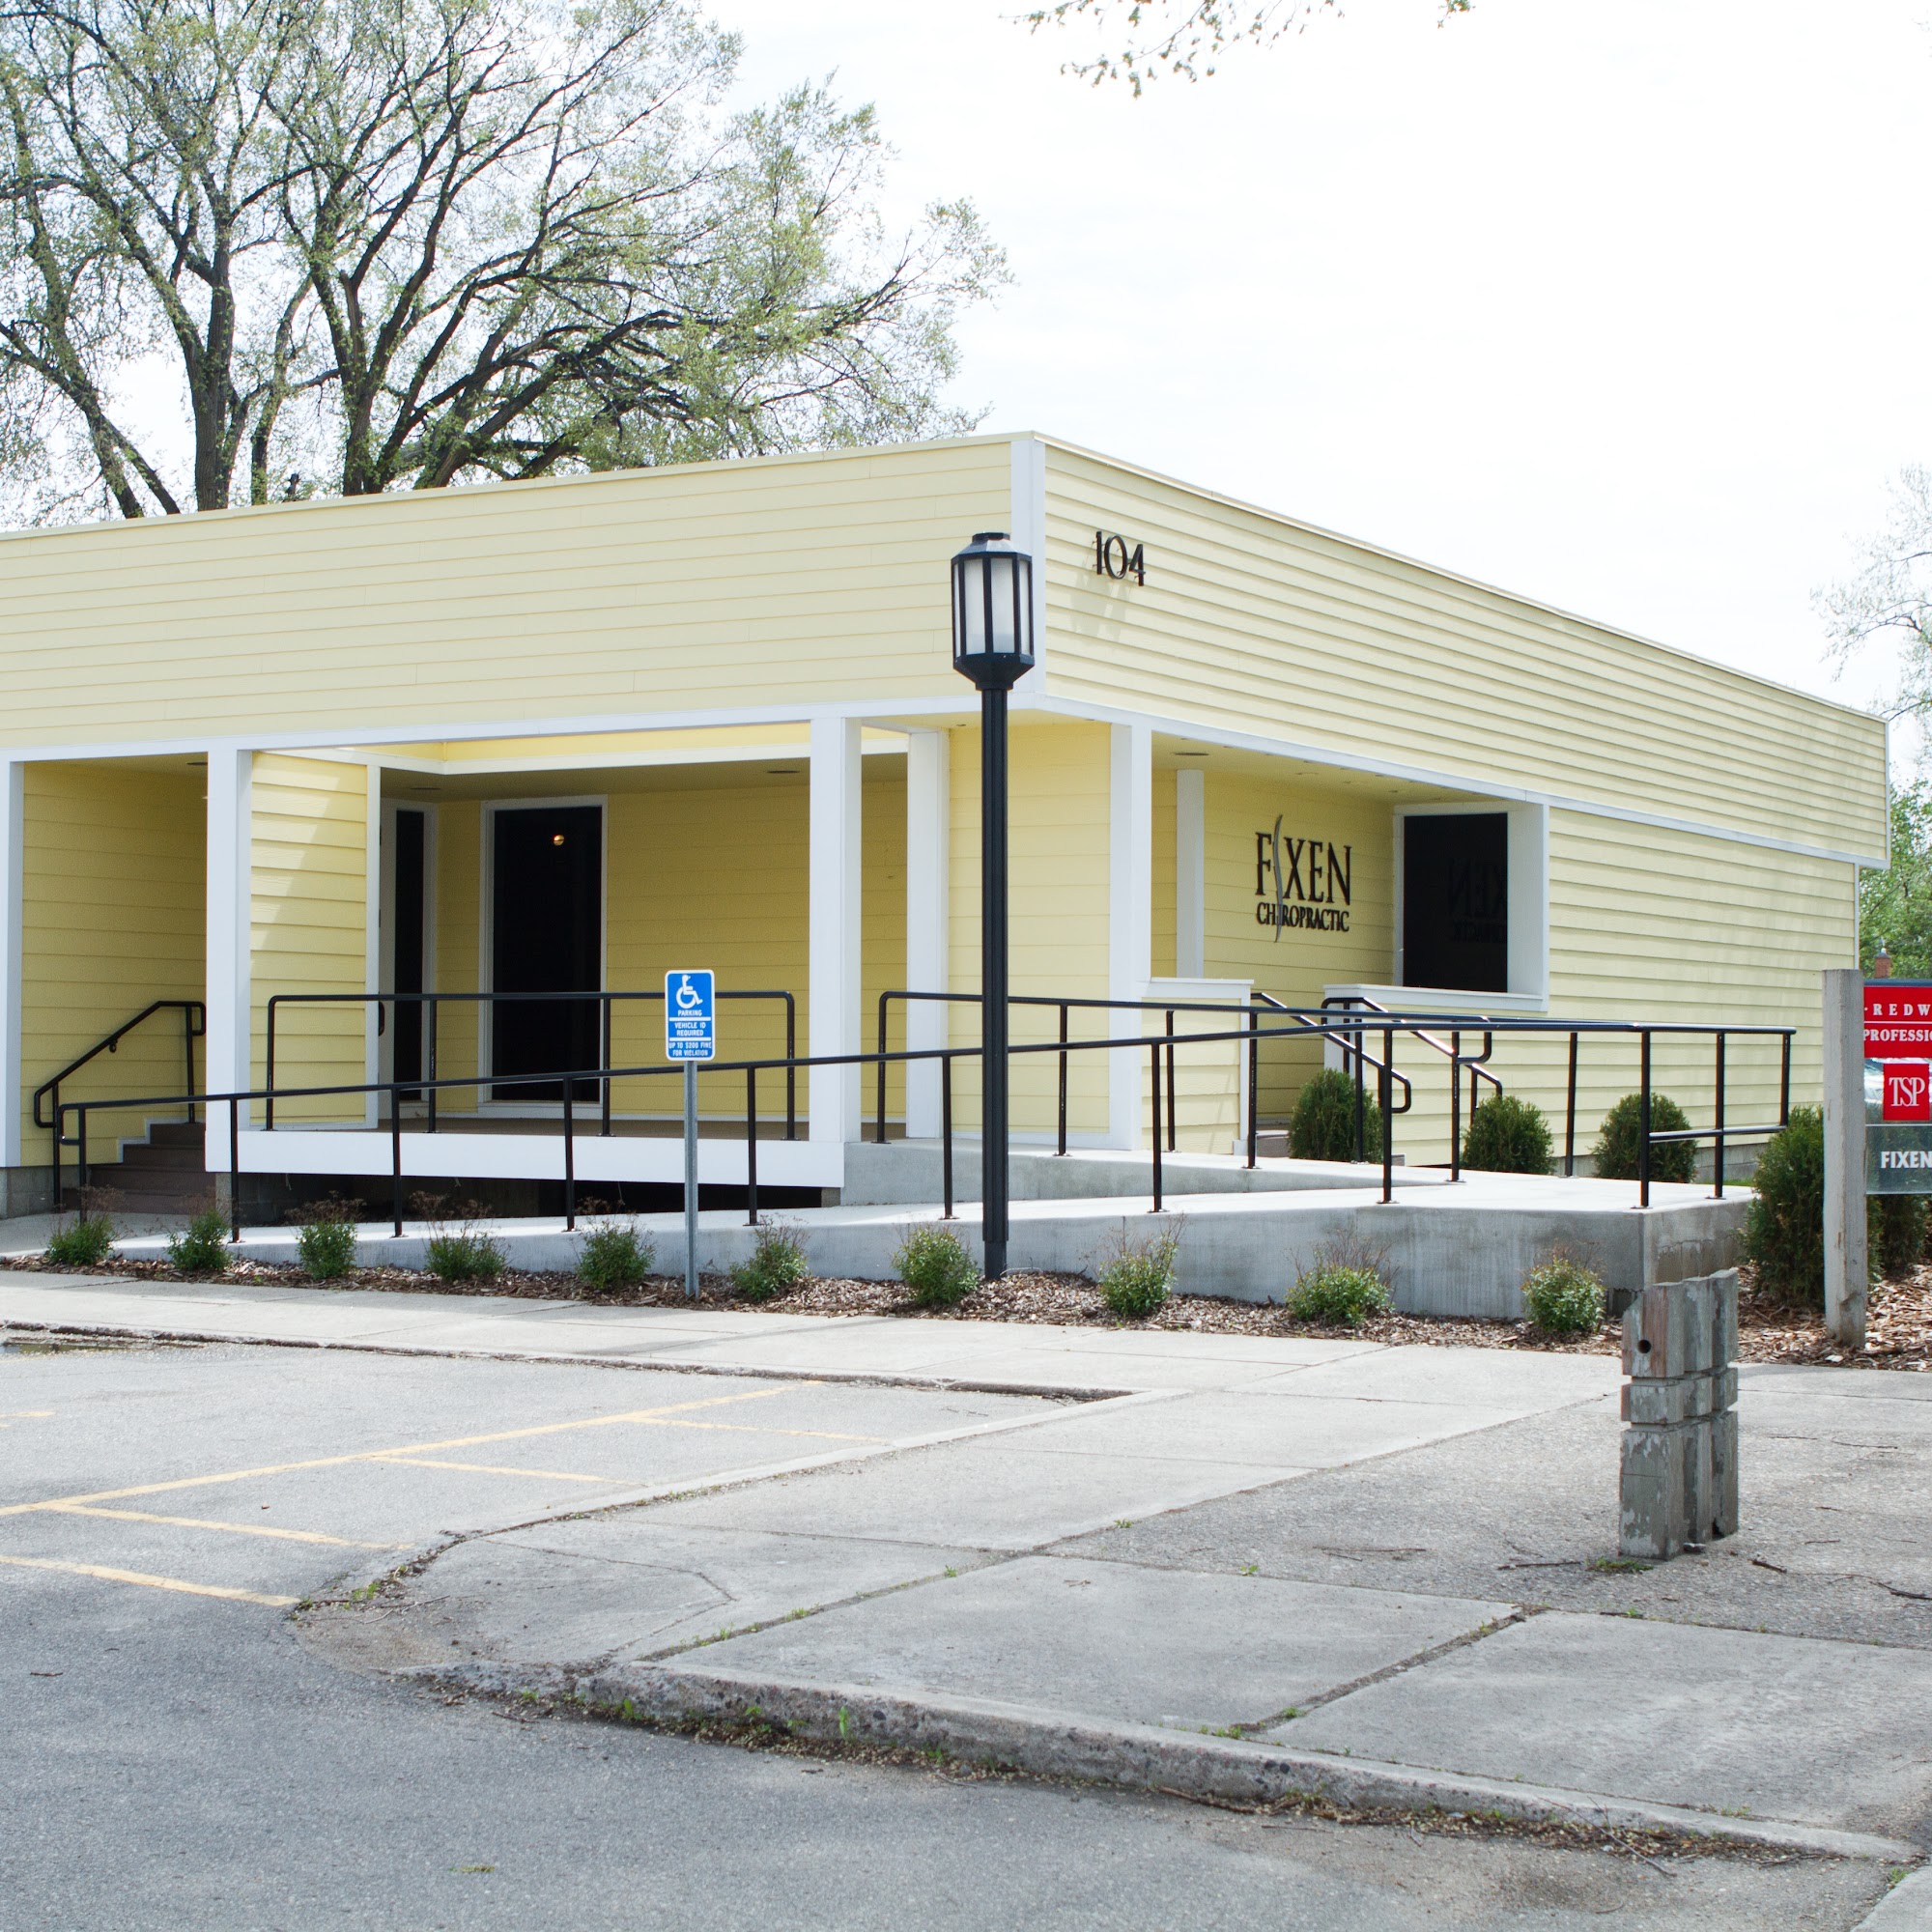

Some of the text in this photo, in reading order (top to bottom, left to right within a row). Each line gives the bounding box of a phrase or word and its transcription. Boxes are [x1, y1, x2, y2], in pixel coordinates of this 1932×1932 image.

[1095, 531, 1146, 586] 104
[1257, 902, 1350, 932] CHIROPRACTIC
[1889, 1076, 1926, 1107] TSP
[1880, 1151, 1932, 1169] FIXEN
